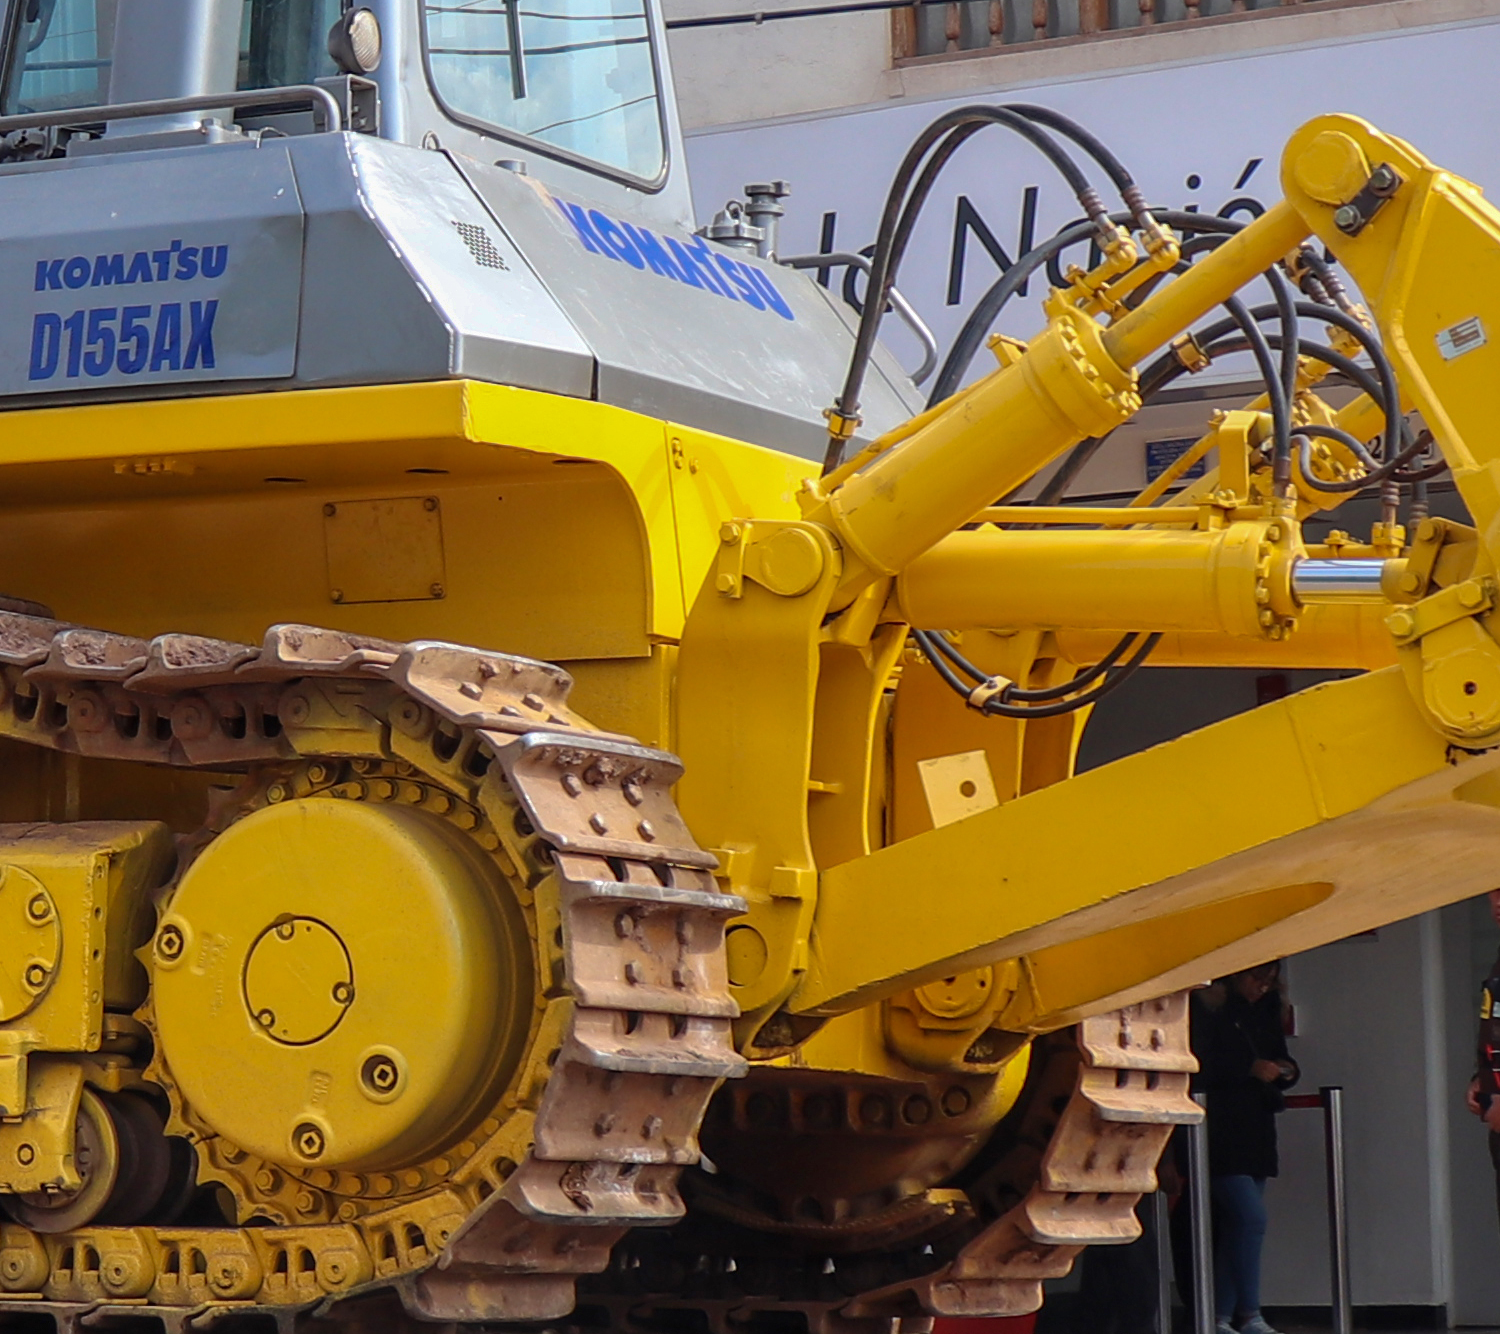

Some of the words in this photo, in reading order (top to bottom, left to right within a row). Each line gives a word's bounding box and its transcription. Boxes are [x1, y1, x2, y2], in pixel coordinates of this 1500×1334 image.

[34, 239, 229, 292] KOMATSU
[551, 196, 796, 322] KOMATSU
[28, 299, 220, 381] D155AX
